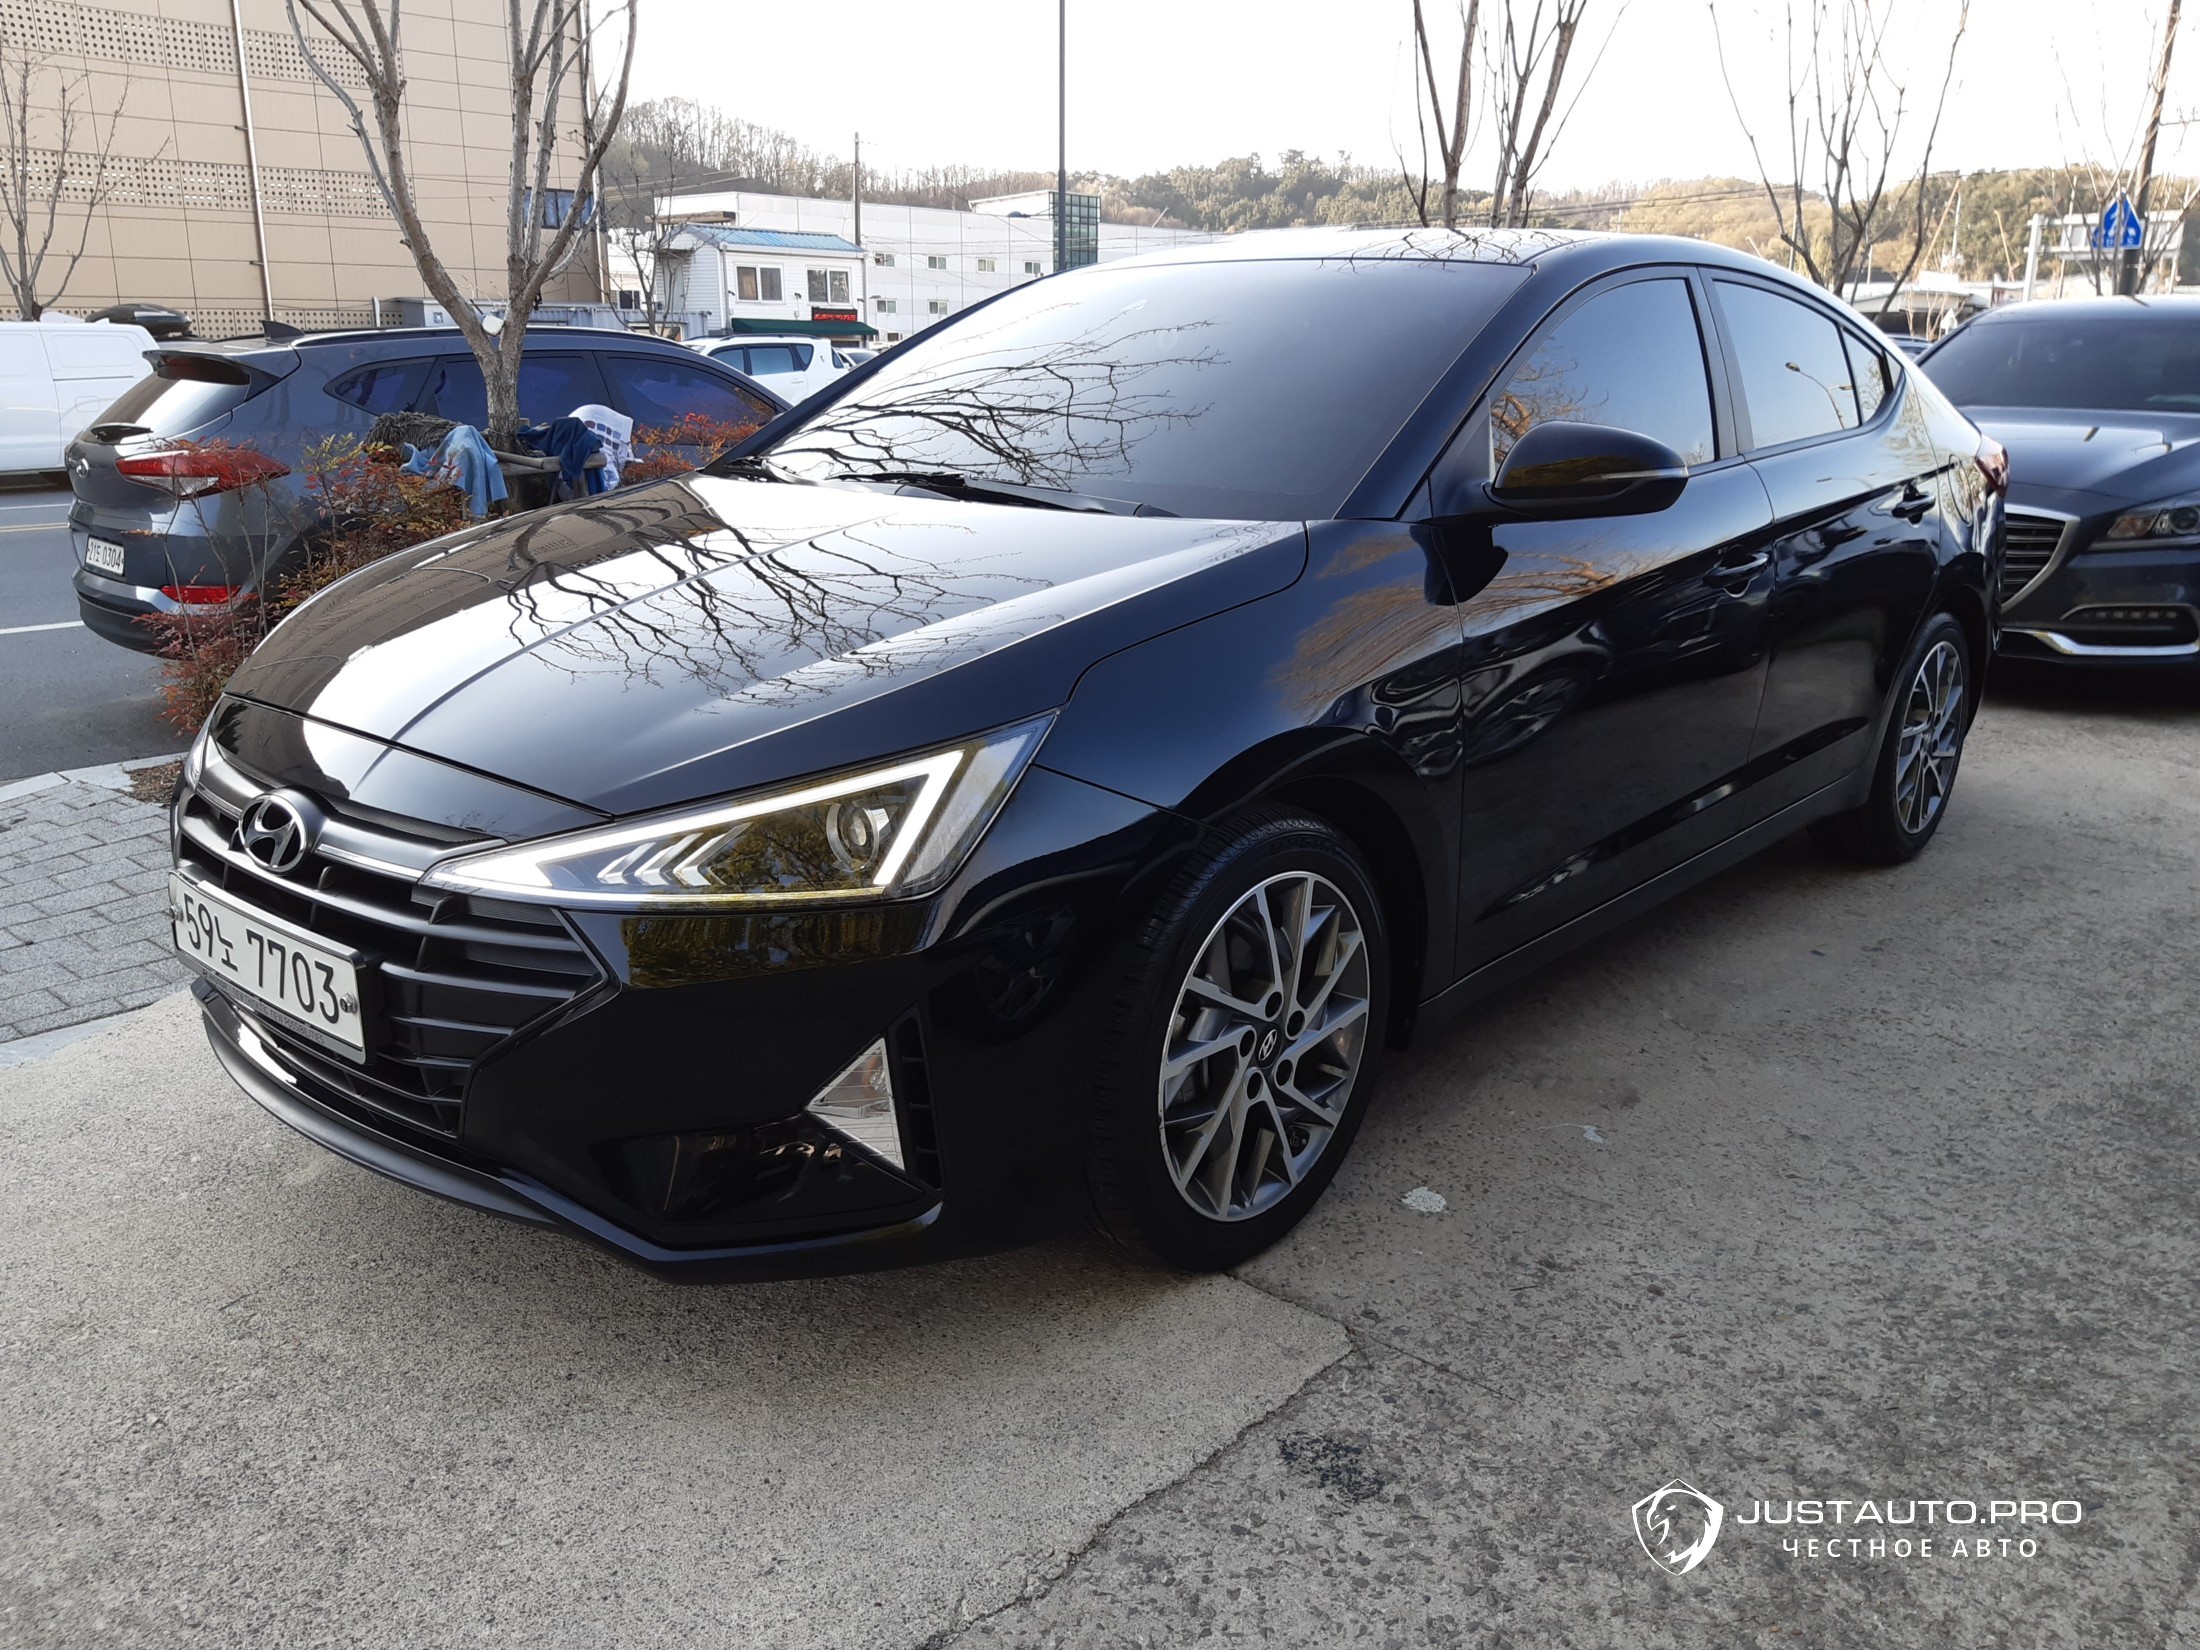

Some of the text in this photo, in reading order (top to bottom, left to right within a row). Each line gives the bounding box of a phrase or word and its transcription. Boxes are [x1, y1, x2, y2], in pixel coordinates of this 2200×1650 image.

[101, 545, 122, 569] 0304
[184, 892, 340, 1024] 59노 7703
